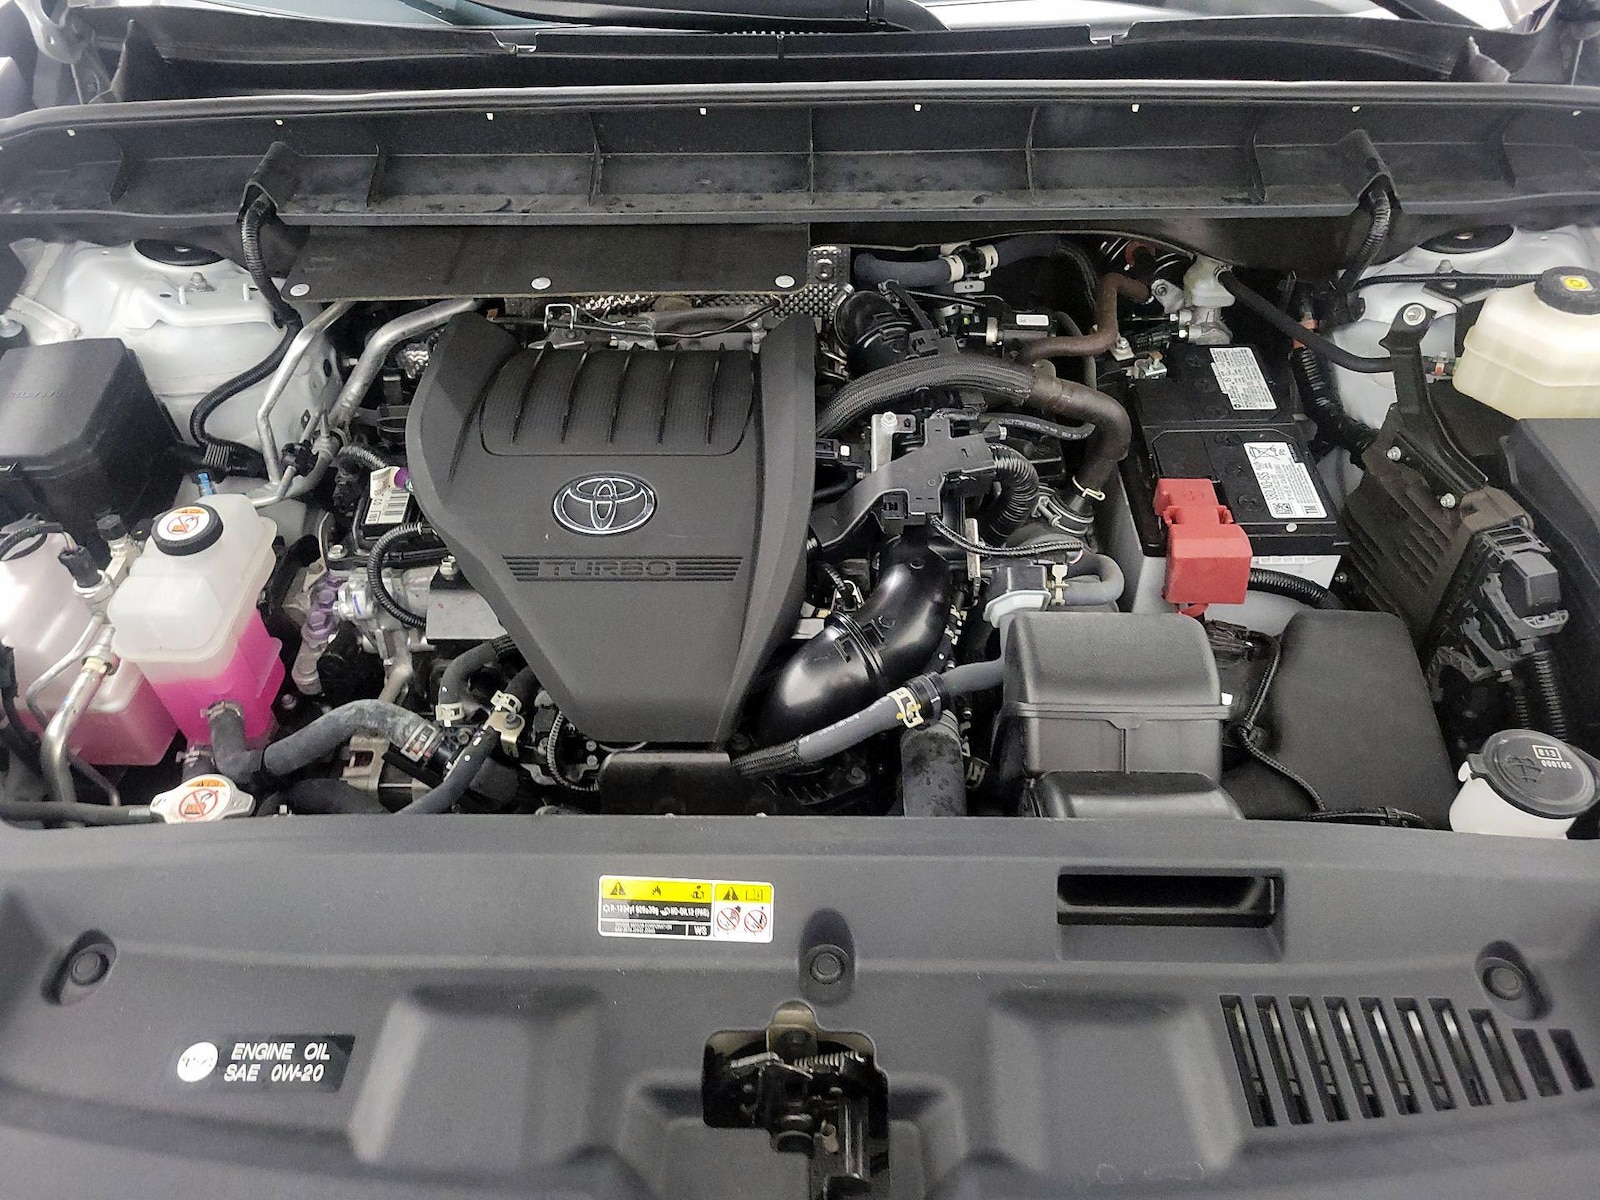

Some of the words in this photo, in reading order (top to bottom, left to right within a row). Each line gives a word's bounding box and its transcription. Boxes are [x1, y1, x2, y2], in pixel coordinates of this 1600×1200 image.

[543, 561, 672, 577] TURBO
[230, 1042, 295, 1060] ENGINE
[304, 1042, 331, 1060] OIL
[223, 1063, 261, 1082] SAE
[270, 1063, 325, 1082] 0W-20
